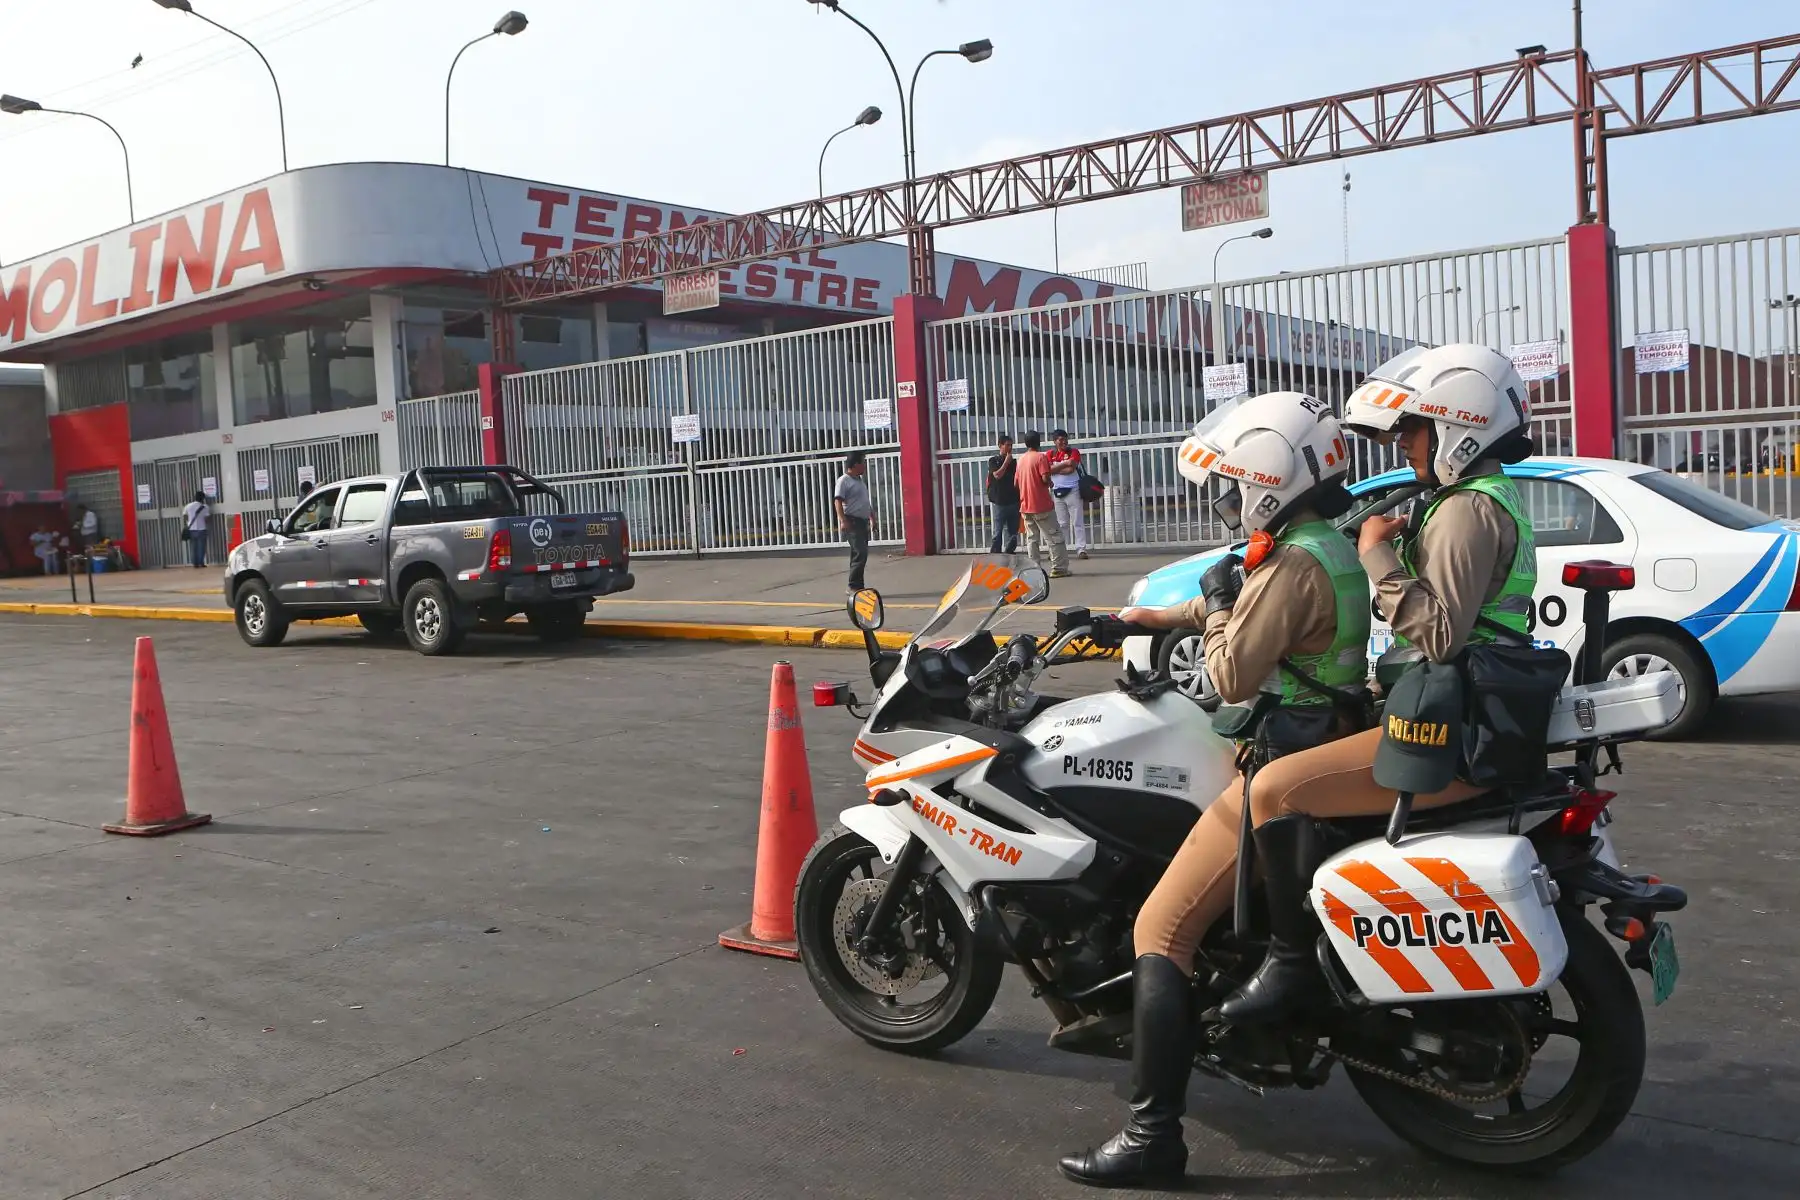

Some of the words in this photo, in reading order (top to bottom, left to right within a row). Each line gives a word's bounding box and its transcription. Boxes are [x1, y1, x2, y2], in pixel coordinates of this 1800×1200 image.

[1186, 172, 1263, 205] INGRESO
[1187, 197, 1264, 227] PEATONAL
[1639, 343, 1683, 352] CLAUSURA
[1640, 350, 1683, 359] TEMPORAL
[1513, 353, 1553, 362] CLAUSURA
[1208, 374, 1240, 383] CLAUSURA
[1209, 380, 1241, 388] TEMPORAL
[533, 544, 605, 564] TOYOTA
[1064, 714, 1102, 727] YAMAHA
[1388, 714, 1448, 746] POLICIA
[1063, 755, 1134, 782] PL-18365
[1352, 909, 1512, 948] POLICIA
